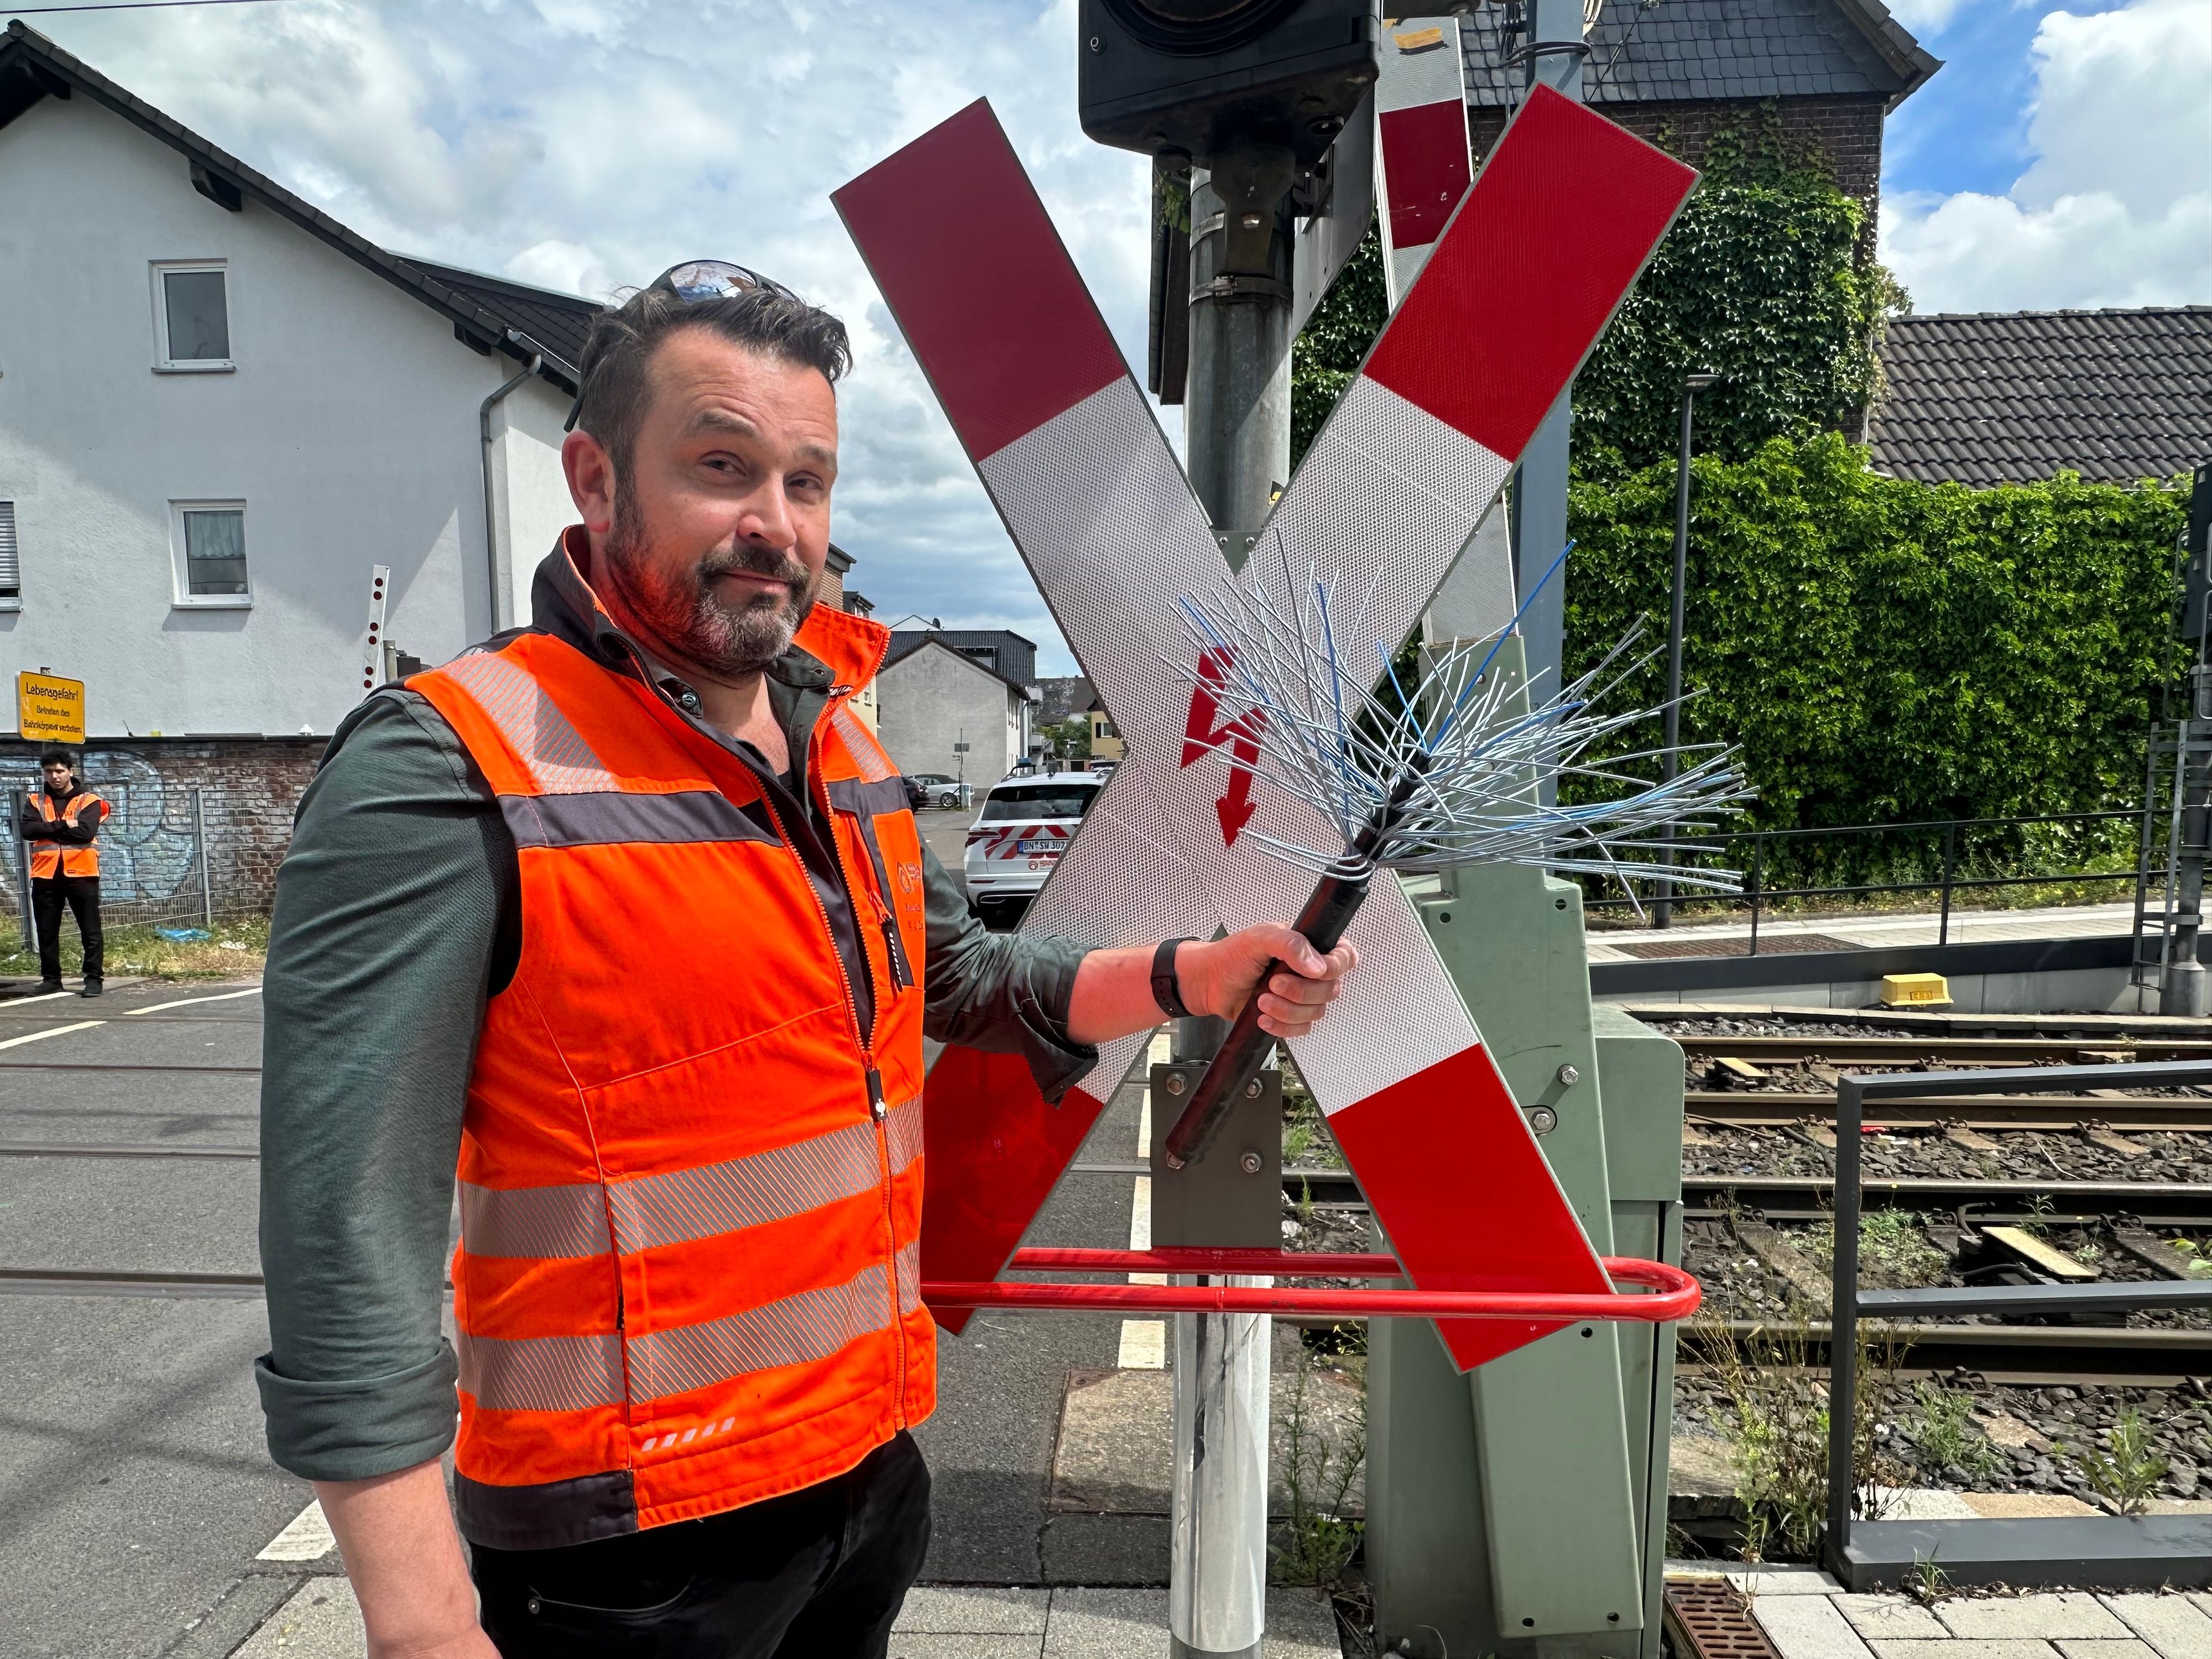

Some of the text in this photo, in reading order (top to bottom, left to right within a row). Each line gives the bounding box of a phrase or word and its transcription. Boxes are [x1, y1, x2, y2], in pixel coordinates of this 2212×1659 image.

[26, 682, 78, 701] Lebensgefahr!
[1024, 841, 1034, 850] BN
[1040, 841, 1050, 849] SW
